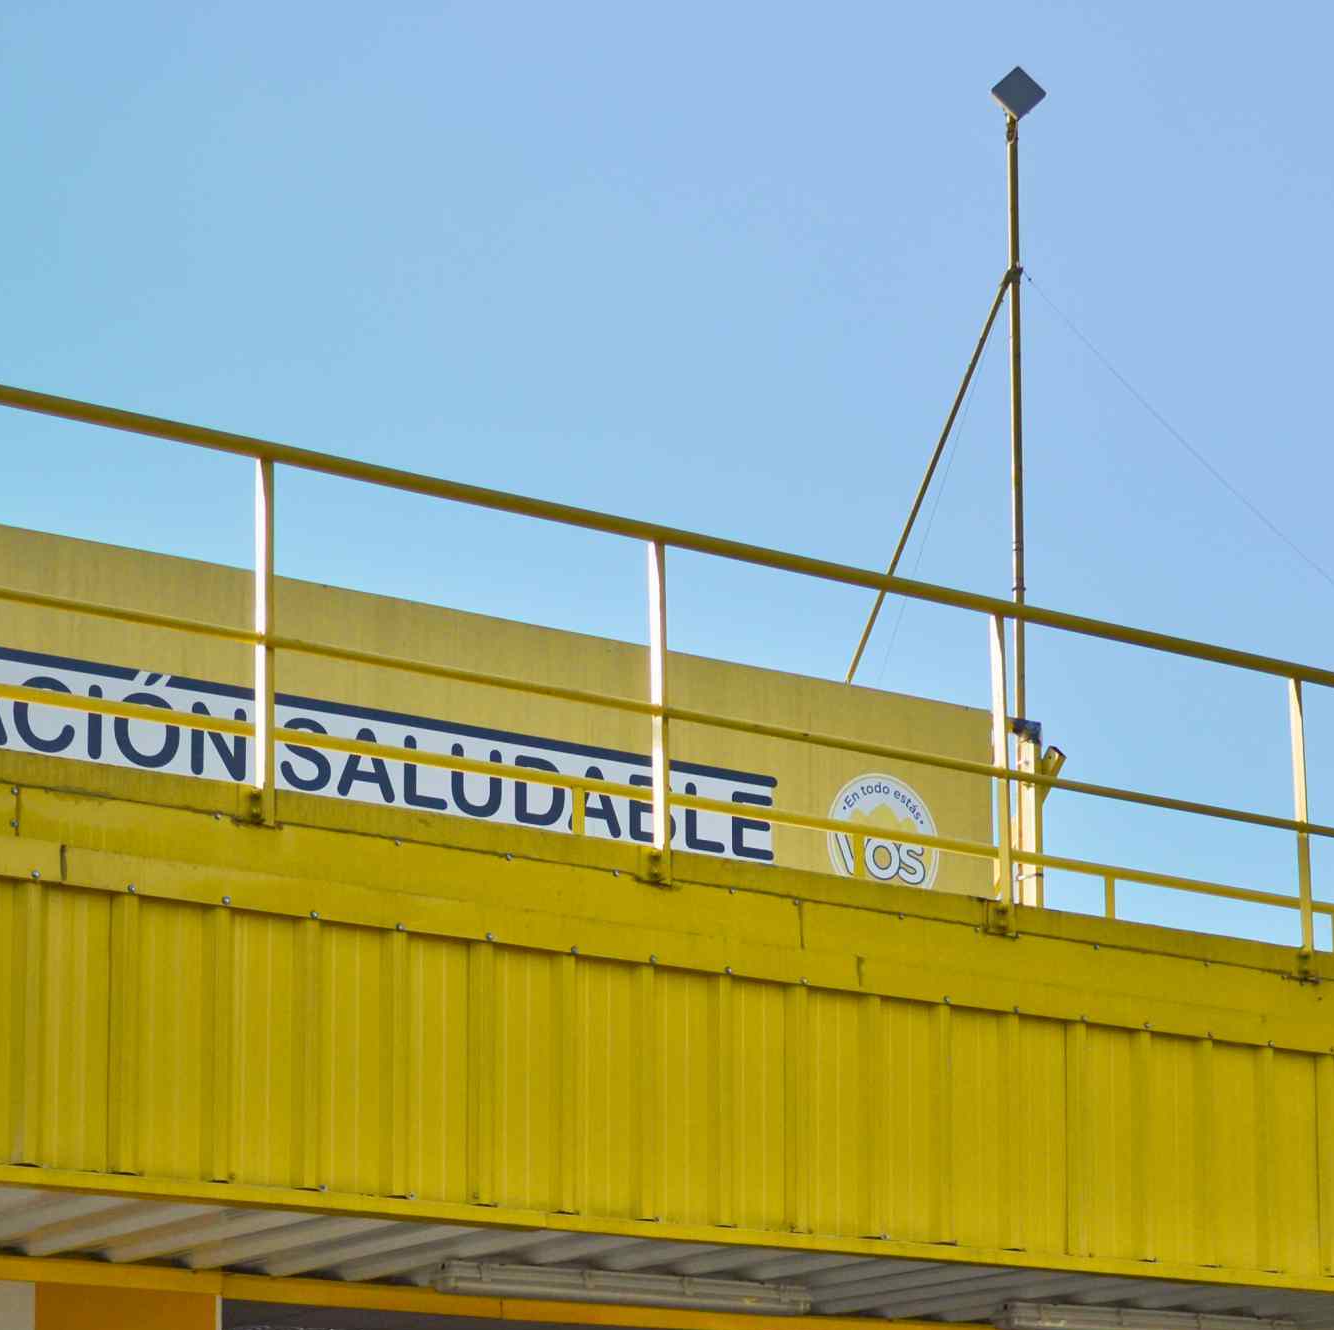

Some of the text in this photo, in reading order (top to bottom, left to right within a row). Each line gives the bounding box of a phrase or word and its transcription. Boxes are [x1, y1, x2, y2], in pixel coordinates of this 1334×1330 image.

[280, 718, 774, 861] SALUDABLE
[861, 782, 890, 795] todo
[894, 789, 921, 820] estás
